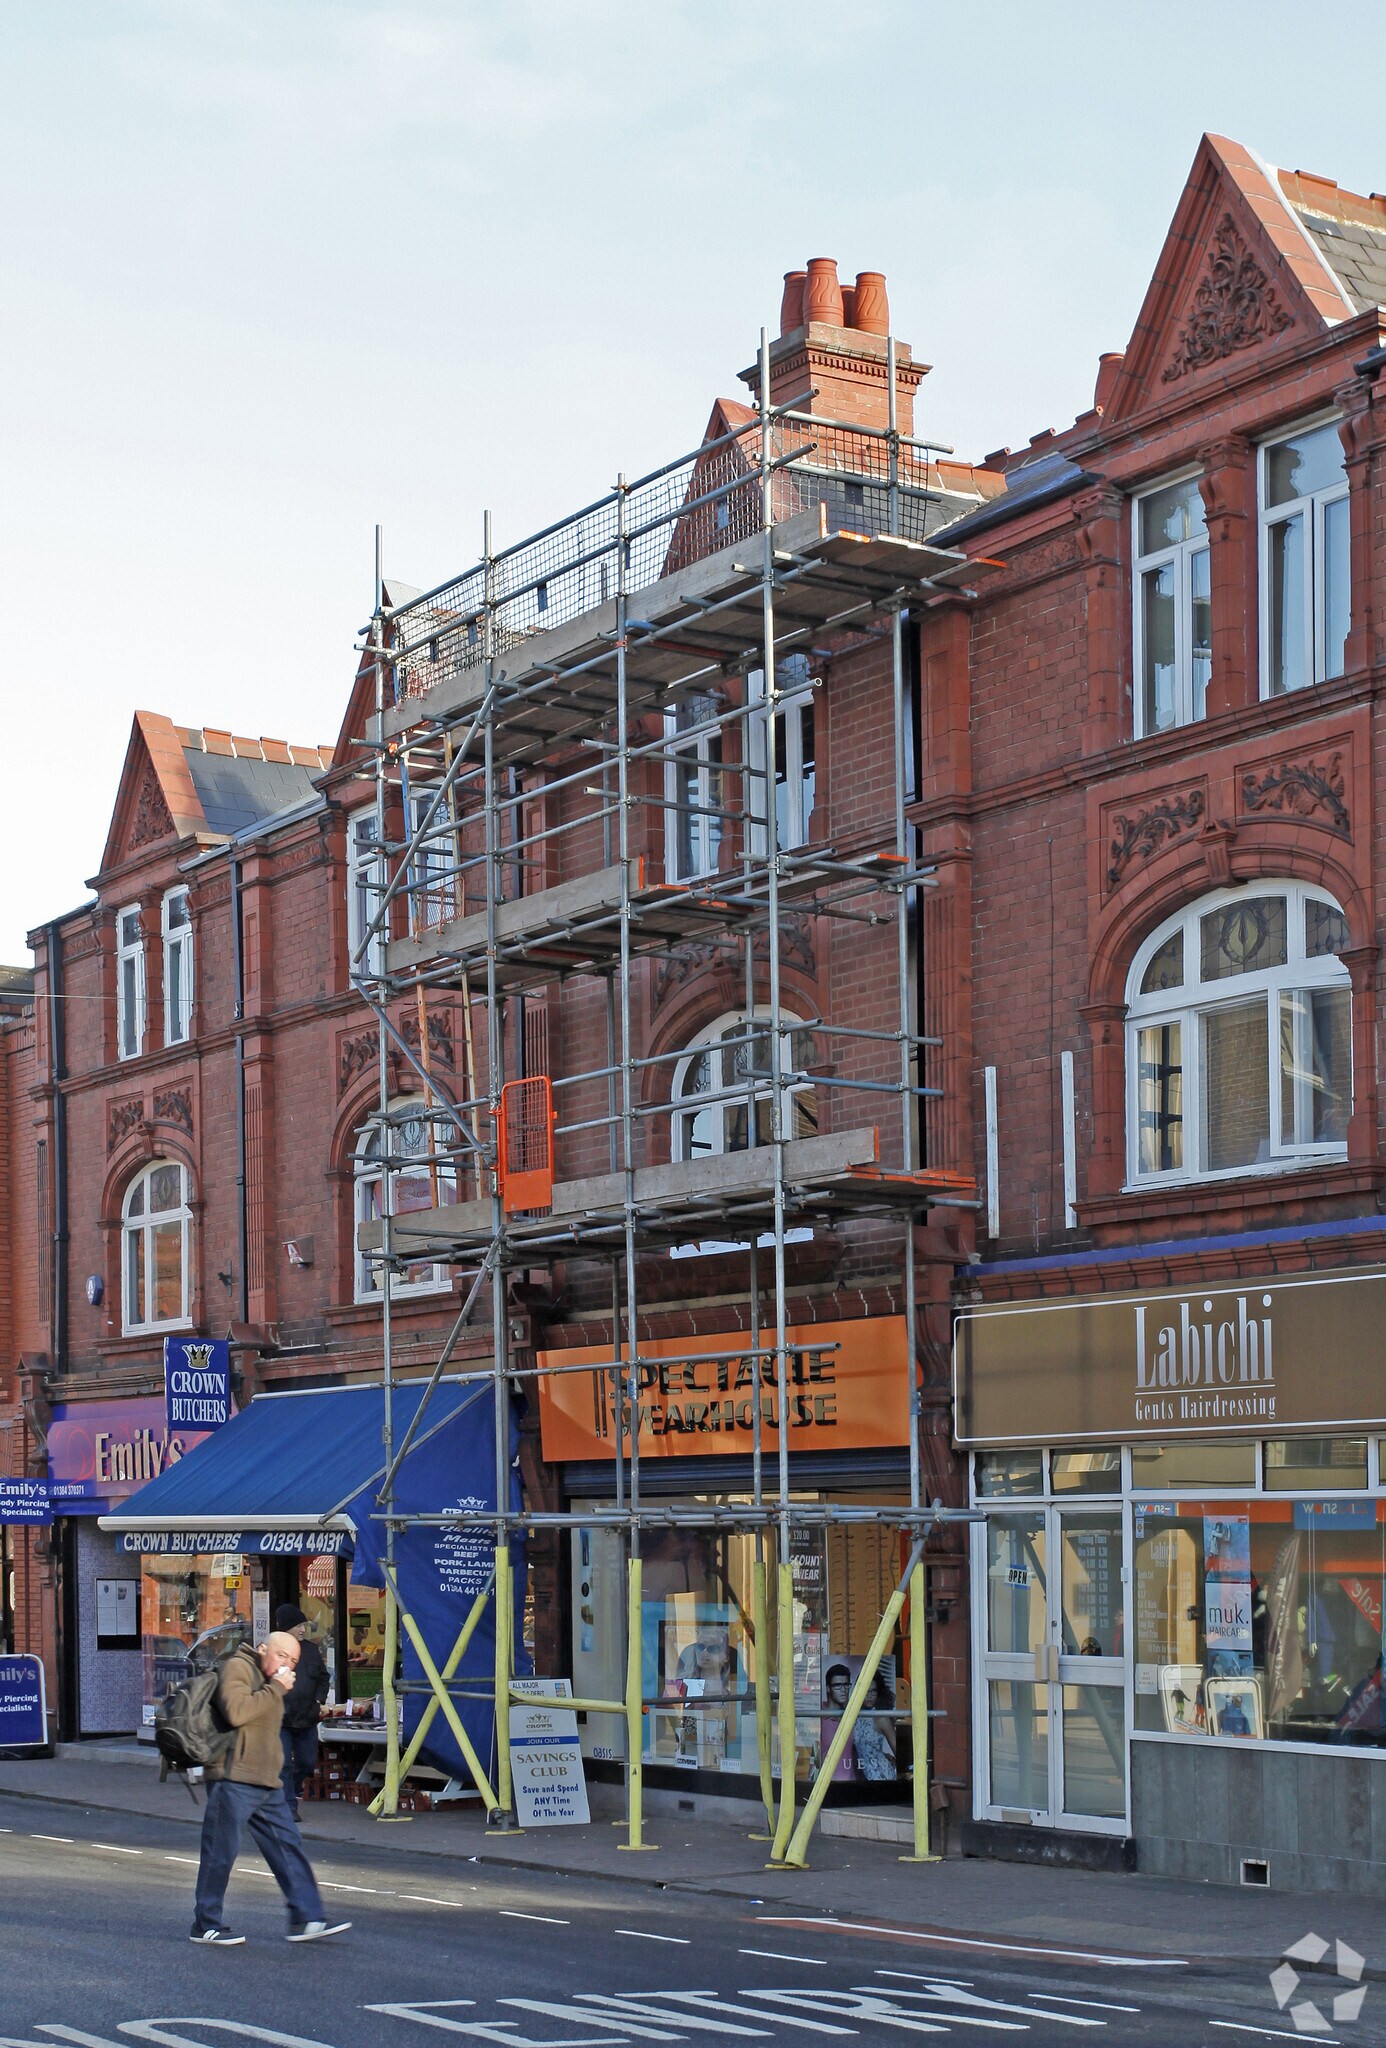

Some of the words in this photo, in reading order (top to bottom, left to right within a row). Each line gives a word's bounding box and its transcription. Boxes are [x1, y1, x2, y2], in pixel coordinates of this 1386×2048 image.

[1134, 1294, 1274, 1388] Labichi
[608, 1350, 836, 1399] SPECTACLE
[171, 1371, 226, 1395] CROWN
[172, 1398, 226, 1423] BUTCHERS
[1135, 1398, 1174, 1421] Gents
[1181, 1392, 1276, 1419] Hairdressing
[611, 1393, 837, 1436] WEARHOUSE
[96, 1428, 182, 1481] Emily's
[0, 1482, 47, 1498] Emily's
[17, 1500, 50, 1508] Piercing
[1, 1508, 44, 1516] Specialists
[123, 1532, 170, 1551] CROWN
[171, 1532, 242, 1551] BUTCHERS
[259, 1532, 303, 1552] 01384
[434, 1543, 489, 1552] SPECIALISTS
[434, 1558, 466, 1567] PORK,
[448, 1576, 482, 1584] PACKS
[1008, 1569, 1028, 1585] OPEN
[1210, 1626, 1246, 1638] HAIRCARE
[4, 1694, 38, 1703] Piercing
[0, 1704, 32, 1713] ecialists
[517, 1752, 577, 1764] SAVINGS
[530, 1766, 568, 1777] CLUB
[522, 1785, 540, 1793] Save
[542, 1785, 555, 1793] and
[557, 1783, 579, 1794] Spend
[534, 1796, 551, 1805] ANY
[551, 1796, 570, 1805] Time
[543, 1808, 557, 1817] The
[558, 1808, 574, 1816] Year
[358, 1984, 1107, 2048] ENTRY
